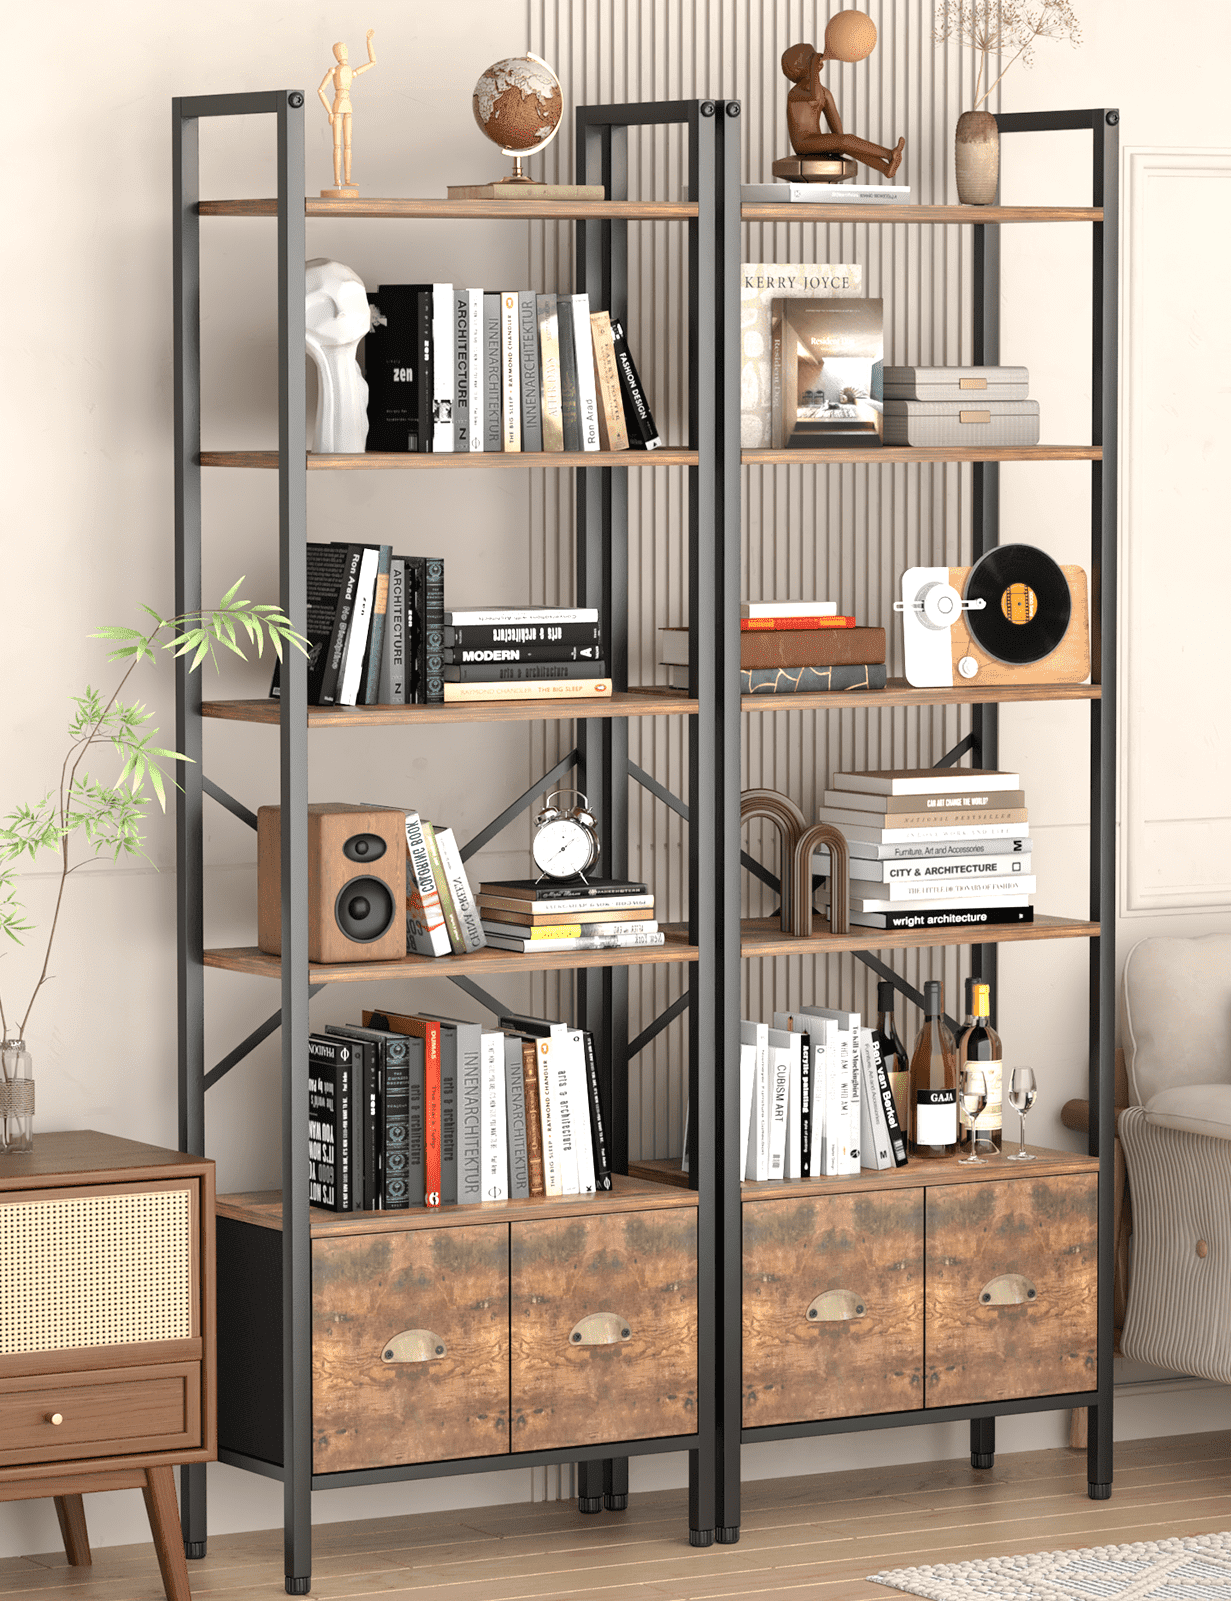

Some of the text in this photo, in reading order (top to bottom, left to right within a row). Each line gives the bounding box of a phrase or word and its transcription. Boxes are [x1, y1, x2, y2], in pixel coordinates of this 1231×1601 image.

[745, 275, 850, 291] KERRY JOYCE
[457, 299, 468, 407] ARCHITECTURE
[521, 300, 537, 428] INNENARCHITEKTUR
[545, 357, 557, 384] DAYS
[772, 338, 781, 408] Resident Dog
[393, 366, 413, 383] zen
[487, 318, 499, 442] INNENARCHITEKTUR
[619, 352, 648, 420] FASHION DESIGN
[507, 417, 515, 429] BIG
[585, 398, 596, 444] Ron Arad
[507, 431, 515, 444] THE
[344, 553, 360, 600] Ron Arad
[341, 605, 351, 621] No
[392, 568, 403, 666] ARCHITECTURE
[492, 626, 537, 643] architecture
[547, 626, 562, 641] arts
[462, 649, 520, 662] MODERN
[580, 647, 592, 658] A
[499, 667, 513, 679] arts
[525, 665, 569, 679] architecture
[460, 687, 532, 696] RAYMOND CHANDLER
[565, 685, 584, 693] SLEEP
[926, 796, 989, 808] CAN ART CHANGE THE WORLD?
[904, 813, 1012, 824] NATIONAL BESTSELLER
[894, 844, 985, 856] Furniture, Art and Accessories
[889, 863, 998, 878] CITY & ARCHITECTURE
[908, 887, 921, 895] THE
[921, 886, 945, 894] LITTLE
[945, 884, 982, 893] DICTIONARY
[992, 882, 1019, 891] FASHION
[892, 913, 988, 928] wright architecture
[852, 1026, 859, 1035] To
[317, 1077, 324, 1094] by
[443, 1077, 455, 1094] arts
[557, 1070, 567, 1087] arts
[801, 1045, 810, 1113] Acrylic painting
[840, 1041, 848, 1111] WHO AM WHO AM
[851, 1054, 859, 1098] Mockingbird
[864, 1043, 872, 1070] Furniture,
[871, 1091, 880, 1125] Accessories
[872, 1041, 898, 1129] Ben van Berkel
[410, 1084, 422, 1102] arts
[542, 1060, 553, 1132] RAYMOND CHANDLER
[775, 1064, 787, 1123] CUBISM ART
[930, 1093, 954, 1103] GAJA
[326, 1098, 335, 1112] The
[464, 1051, 480, 1194] INNENARCHITEKTUR
[510, 1062, 527, 1190] INNENARCHITEKTUR
[560, 1100, 573, 1152] architecture
[321, 1123, 335, 1144] YOU
[410, 1114, 421, 1166] architecture
[443, 1108, 455, 1162] architecture
[321, 1143, 335, 1165] IT'S
[308, 1160, 316, 1182] YO
[322, 1186, 335, 1206] IT'S
